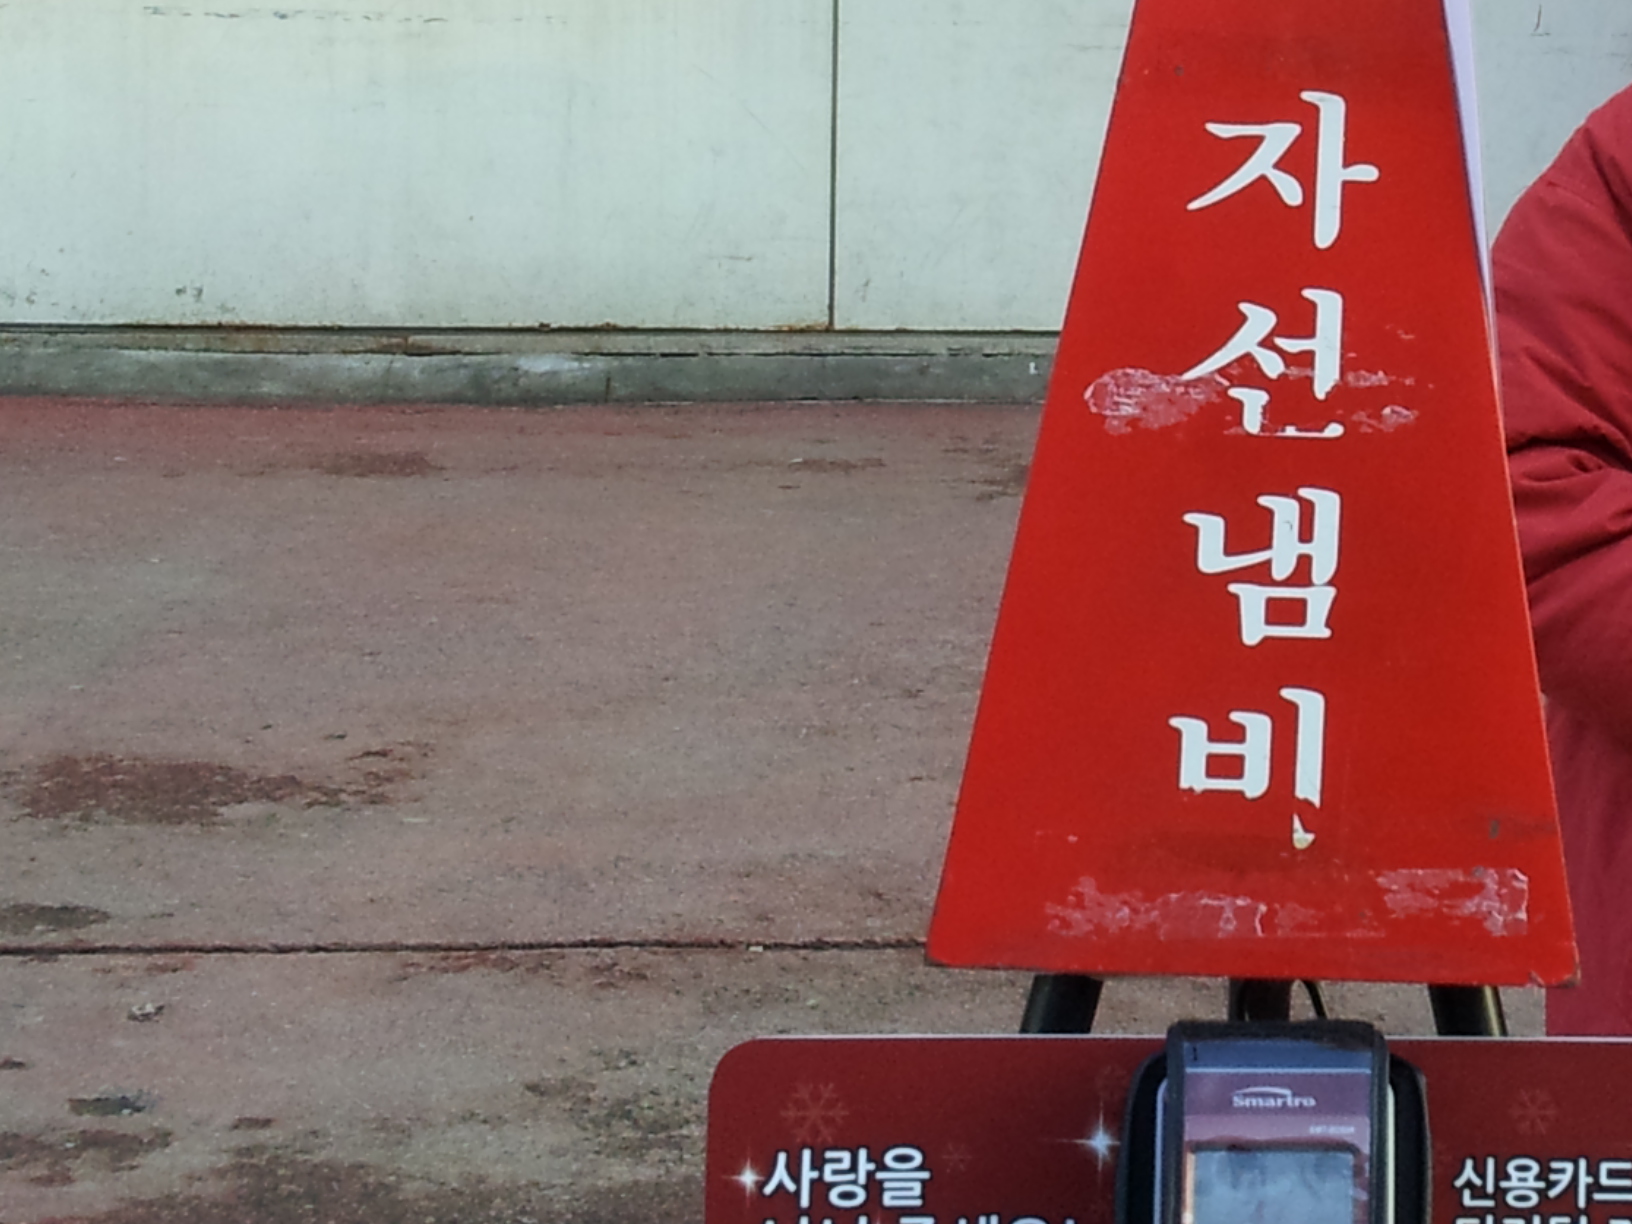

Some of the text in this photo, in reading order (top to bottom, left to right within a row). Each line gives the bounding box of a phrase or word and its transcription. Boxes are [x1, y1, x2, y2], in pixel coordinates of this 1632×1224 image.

[1166, 91, 1379, 850] 자선냄비
[1231, 1088, 1316, 1107] Smartro
[762, 1146, 931, 1209] 사랑을
